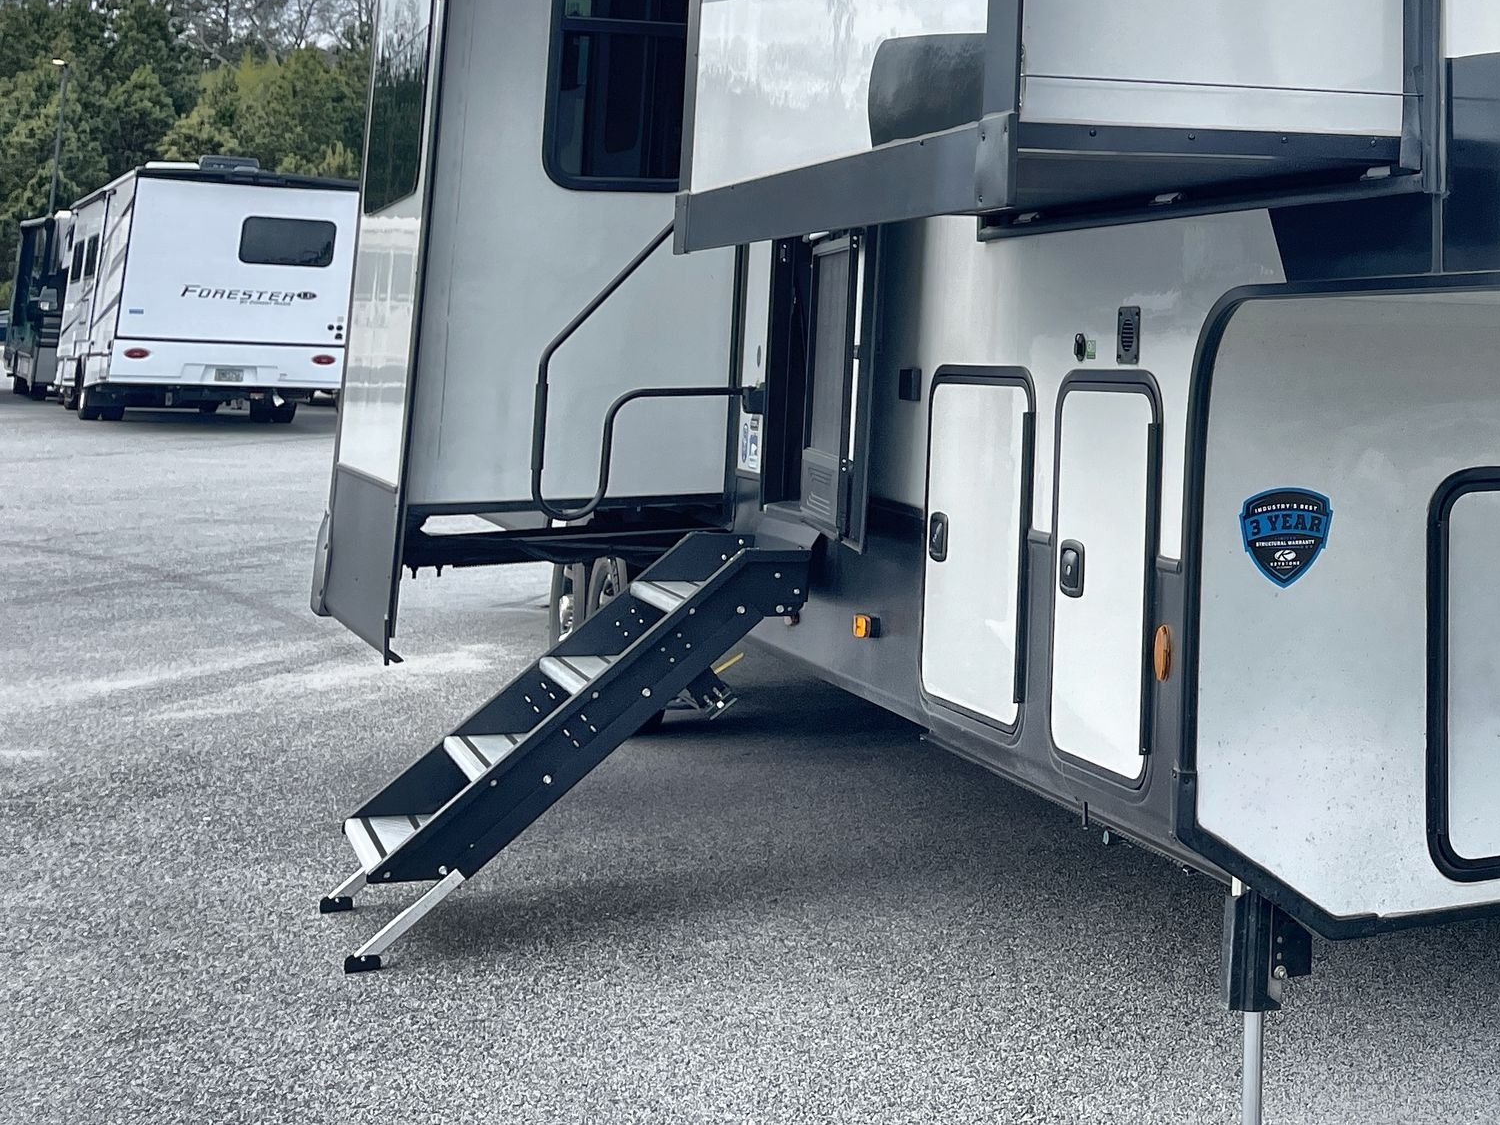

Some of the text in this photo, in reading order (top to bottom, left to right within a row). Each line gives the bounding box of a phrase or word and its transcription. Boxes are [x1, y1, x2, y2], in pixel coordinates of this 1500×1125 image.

[180, 284, 296, 302] FORESTER
[1299, 503, 1318, 512] BEST
[1250, 513, 1323, 536] 3 YEAR
